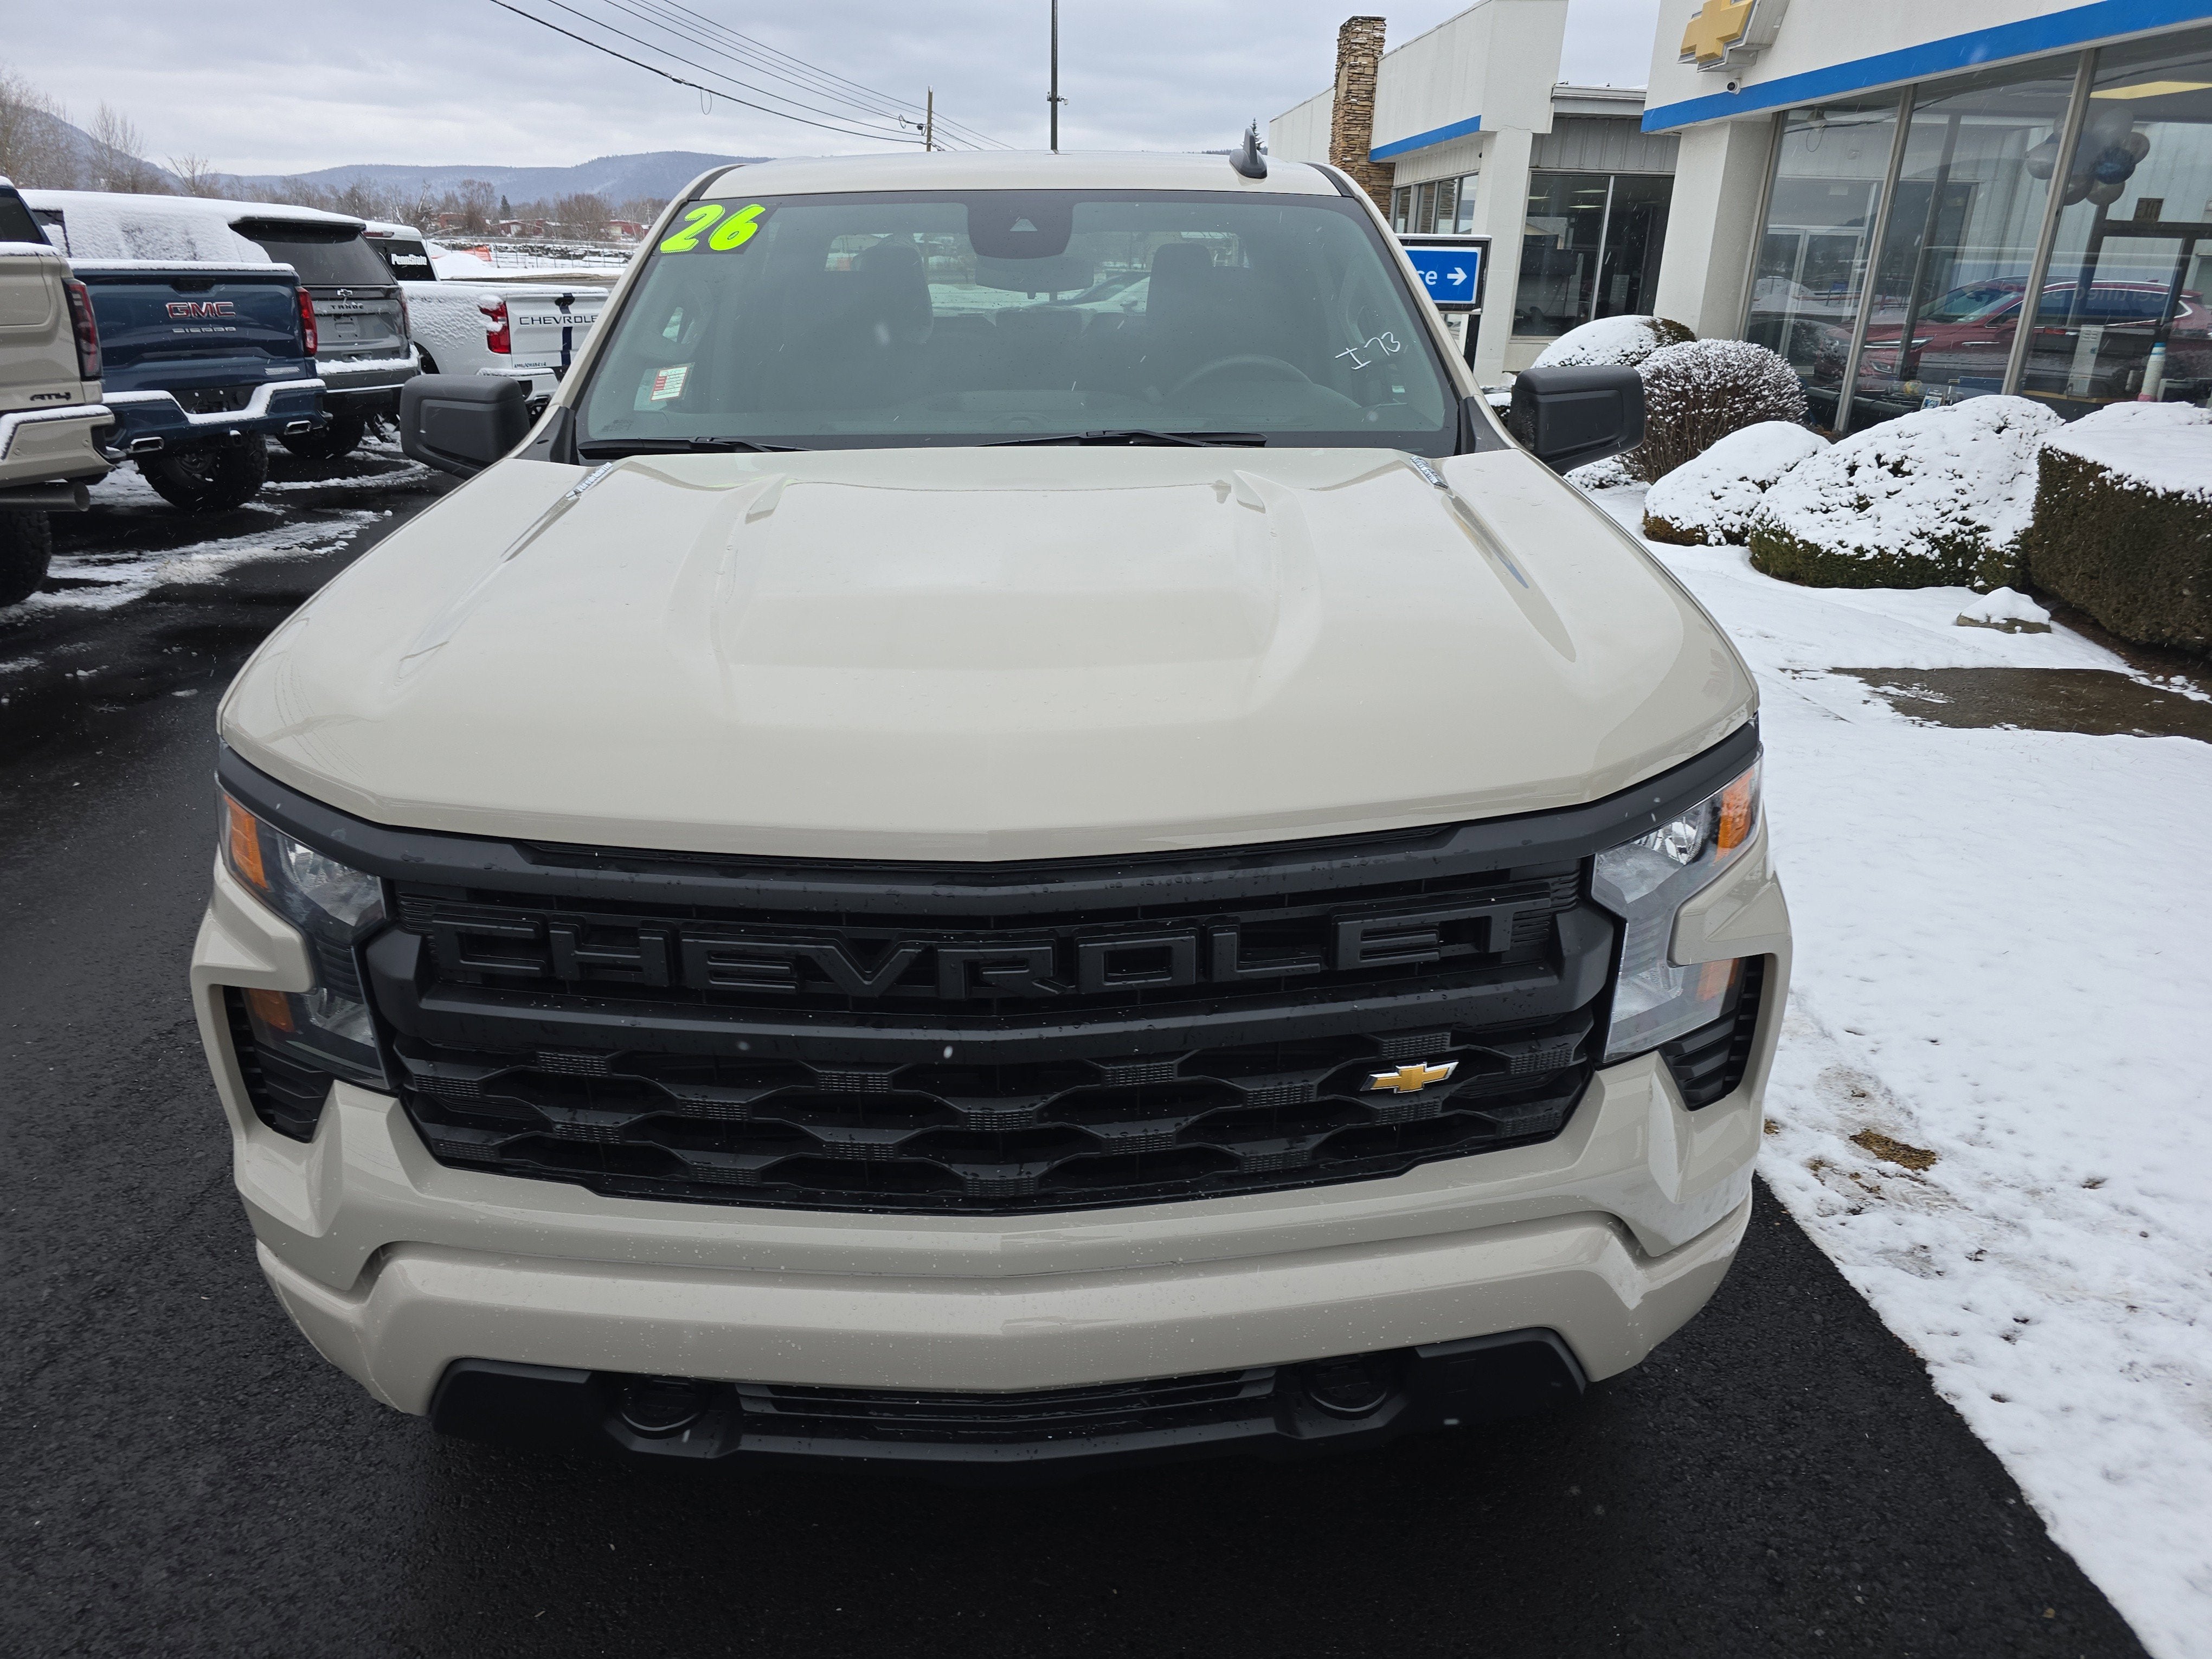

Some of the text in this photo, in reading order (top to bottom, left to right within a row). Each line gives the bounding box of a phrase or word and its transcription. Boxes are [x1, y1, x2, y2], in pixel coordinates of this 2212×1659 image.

[660, 203, 766, 254] 26
[165, 301, 236, 319] GMC
[519, 315, 599, 325] CHEVROLE
[29, 391, 72, 401] AT4
[430, 896, 1552, 1000] CHEVROLET
